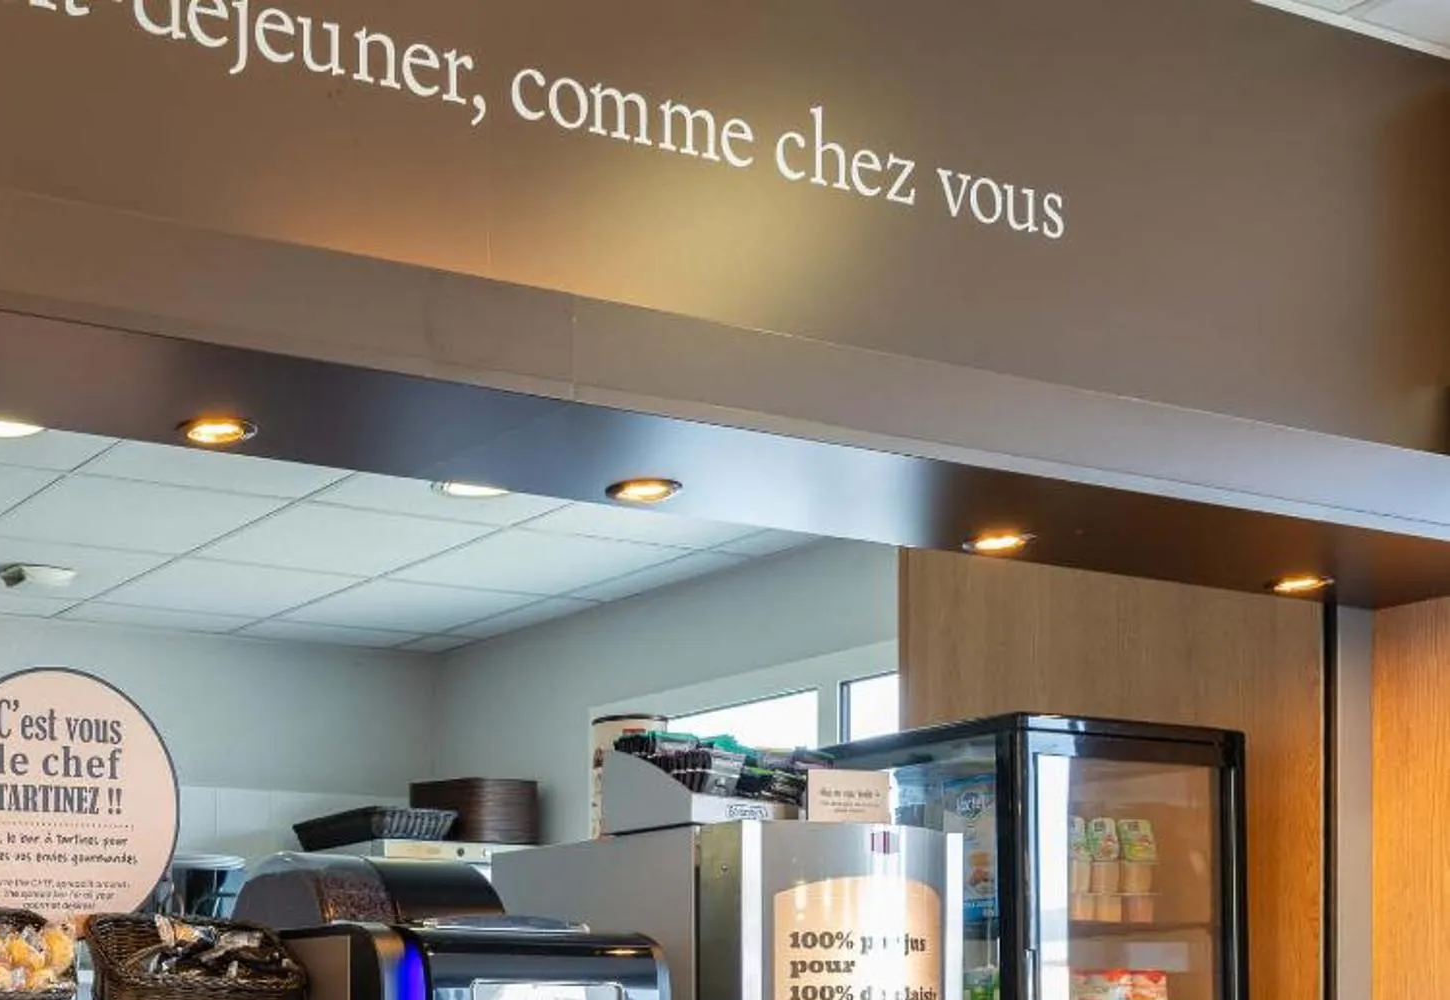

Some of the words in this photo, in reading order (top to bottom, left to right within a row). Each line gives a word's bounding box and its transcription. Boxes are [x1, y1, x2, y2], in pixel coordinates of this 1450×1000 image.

[510, 66, 754, 168] comme
[775, 106, 916, 206] chez
[936, 165, 1066, 239] vous
[65, 716, 123, 745] vous
[41, 745, 123, 780] chef
[788, 930, 855, 950] 100%
[904, 933, 927, 957] jus
[789, 959, 856, 979] pour
